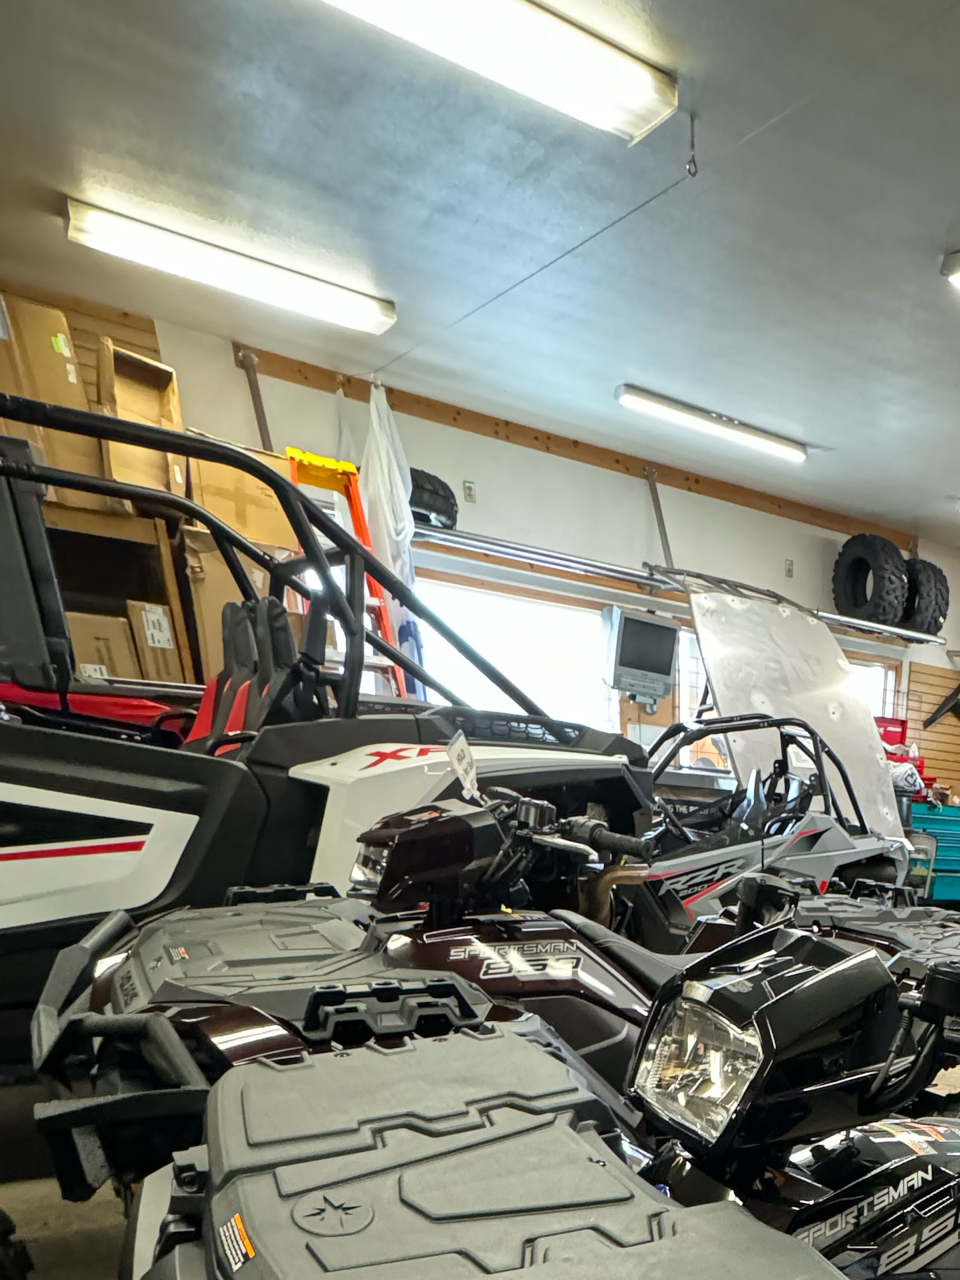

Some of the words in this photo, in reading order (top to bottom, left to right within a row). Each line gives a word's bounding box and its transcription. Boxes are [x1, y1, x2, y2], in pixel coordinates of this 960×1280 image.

[675, 804, 689, 814] THE
[658, 858, 747, 897] RZR
[679, 884, 708, 897] 200
[448, 942, 578, 960] SPORTSMAN
[797, 1164, 932, 1247] SPORTSMAN
